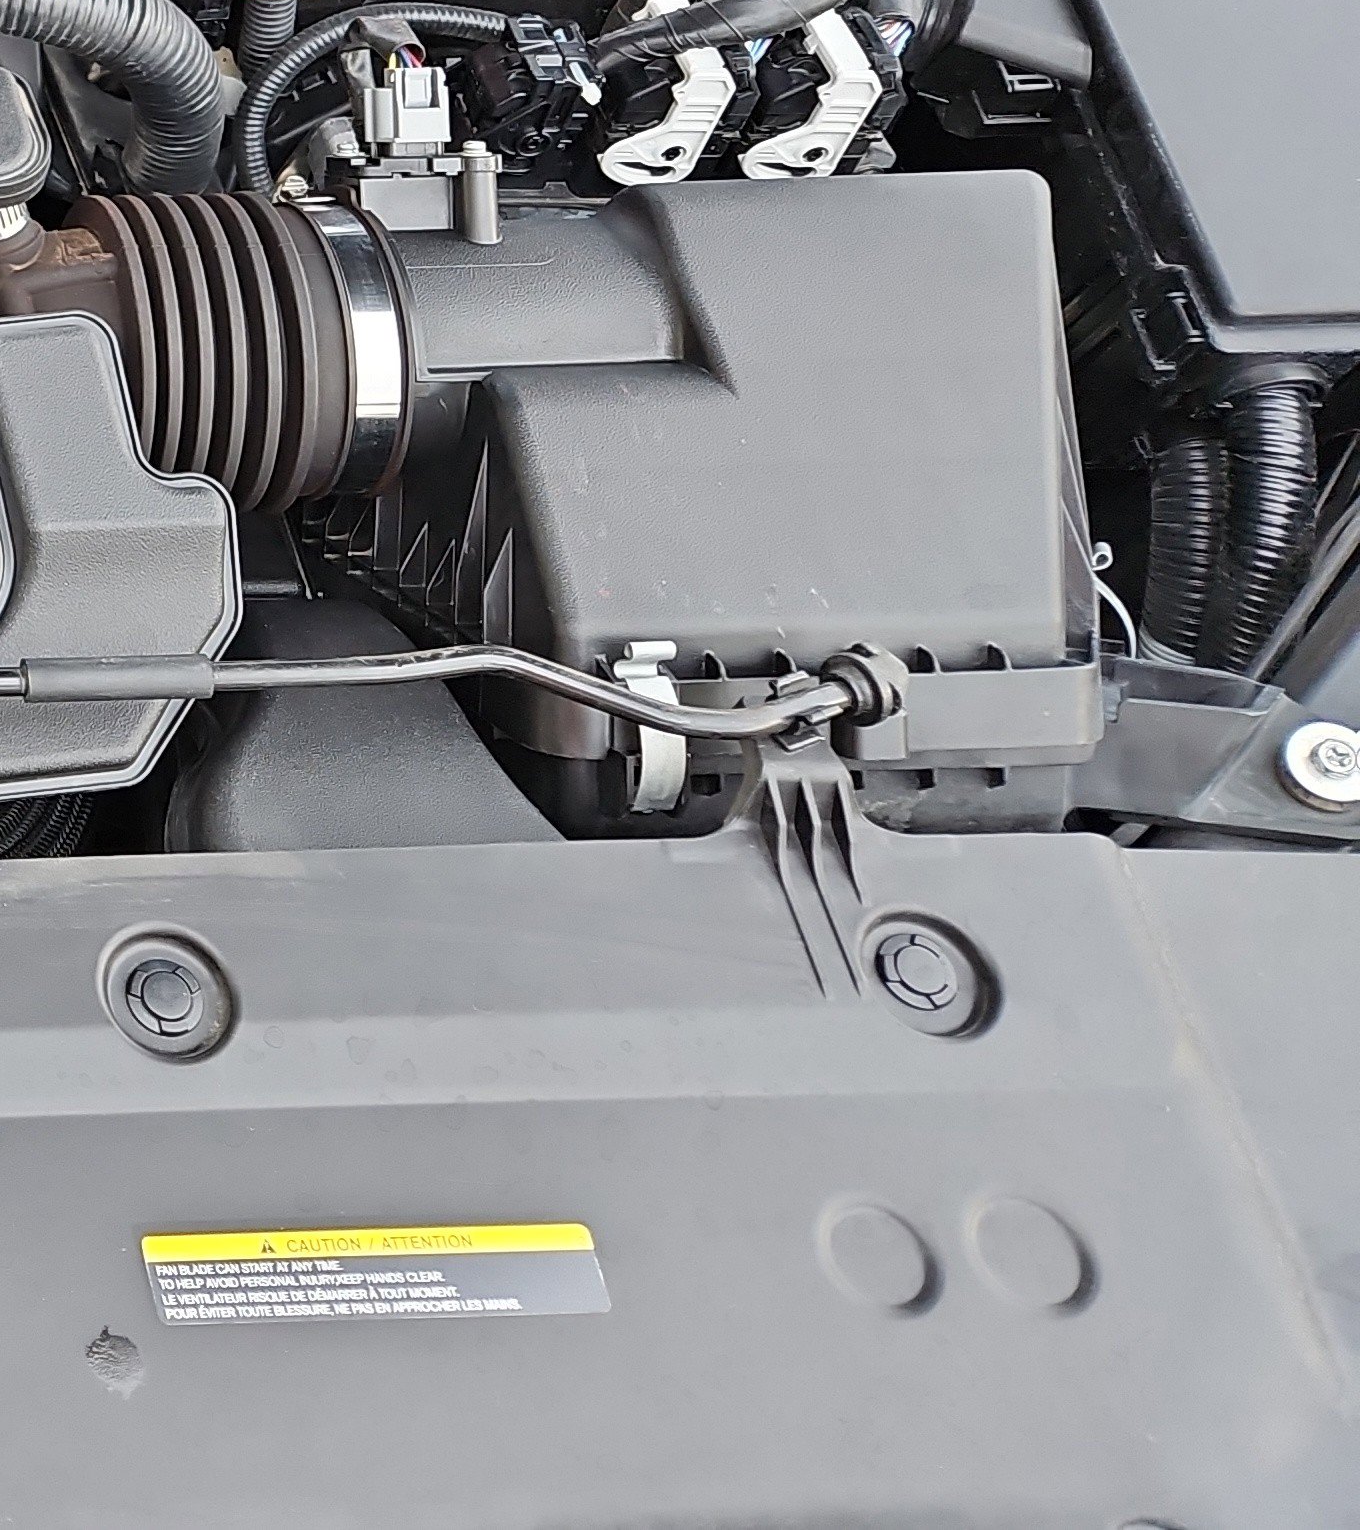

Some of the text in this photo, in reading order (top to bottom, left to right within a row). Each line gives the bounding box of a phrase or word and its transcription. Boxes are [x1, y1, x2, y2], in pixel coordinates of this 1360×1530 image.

[287, 1237, 362, 1253] CAUTION
[381, 1235, 472, 1250] ATTENTION
[155, 1260, 344, 1276] FAN BLADE CAN START AT ANY TIME.
[158, 1278, 174, 1290] TO
[176, 1277, 204, 1290] HELP
[206, 1276, 239, 1289] AVOID
[240, 1274, 299, 1288] PERSONAL
[365, 1272, 405, 1284] HANDS
[406, 1271, 446, 1283] CLEAR.
[161, 1285, 460, 1306] LE VENTILATEUR RISQUE DE DÉMARRER À TOUT MOMENT.
[164, 1307, 199, 1320] POUR
[199, 1304, 237, 1319] ÉVITER
[237, 1305, 274, 1318] TOUTE
[274, 1304, 334, 1317] BLESSURE,
[333, 1303, 351, 1315] NE
[352, 1302, 375, 1314] PAS
[375, 1302, 392, 1314] EN
[392, 1300, 461, 1313] APPROCHER
[461, 1299, 484, 1311] LES
